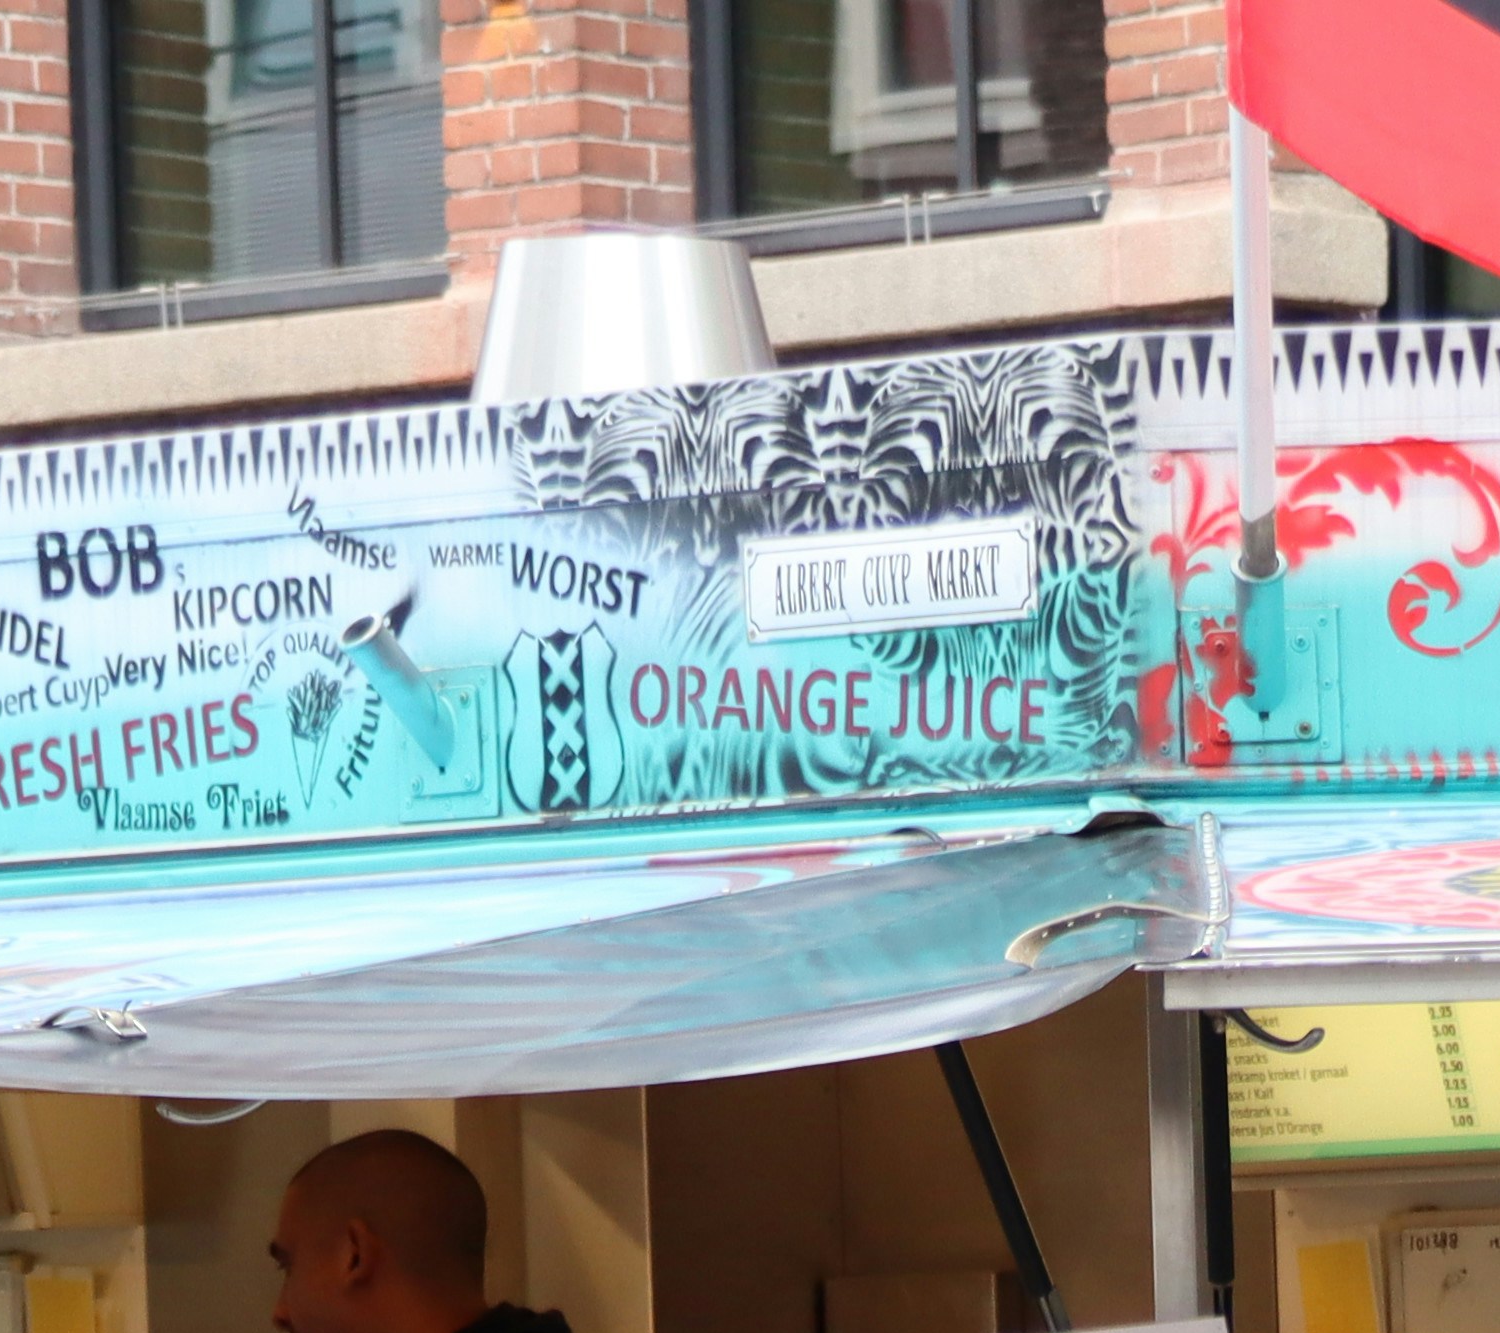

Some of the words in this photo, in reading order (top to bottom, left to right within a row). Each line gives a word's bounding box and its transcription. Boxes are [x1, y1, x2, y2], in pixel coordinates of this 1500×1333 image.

[173, 574, 333, 632] KIPCORN
[429, 543, 504, 569] WARME
[511, 542, 649, 618] WORST
[774, 558, 848, 617] ALBERT
[862, 554, 912, 610] CUYP
[927, 544, 1003, 603] MARKT
[105, 653, 167, 692] Very
[177, 636, 251, 672] Nice!
[248, 648, 278, 694] TOP
[44, 673, 110, 715] Cuyp
[630, 663, 872, 737] ORANGE
[889, 668, 1048, 746] JUICE
[120, 692, 259, 782] FRIES
[78, 785, 195, 831] Vlaamse
[206, 782, 291, 829] Friet
